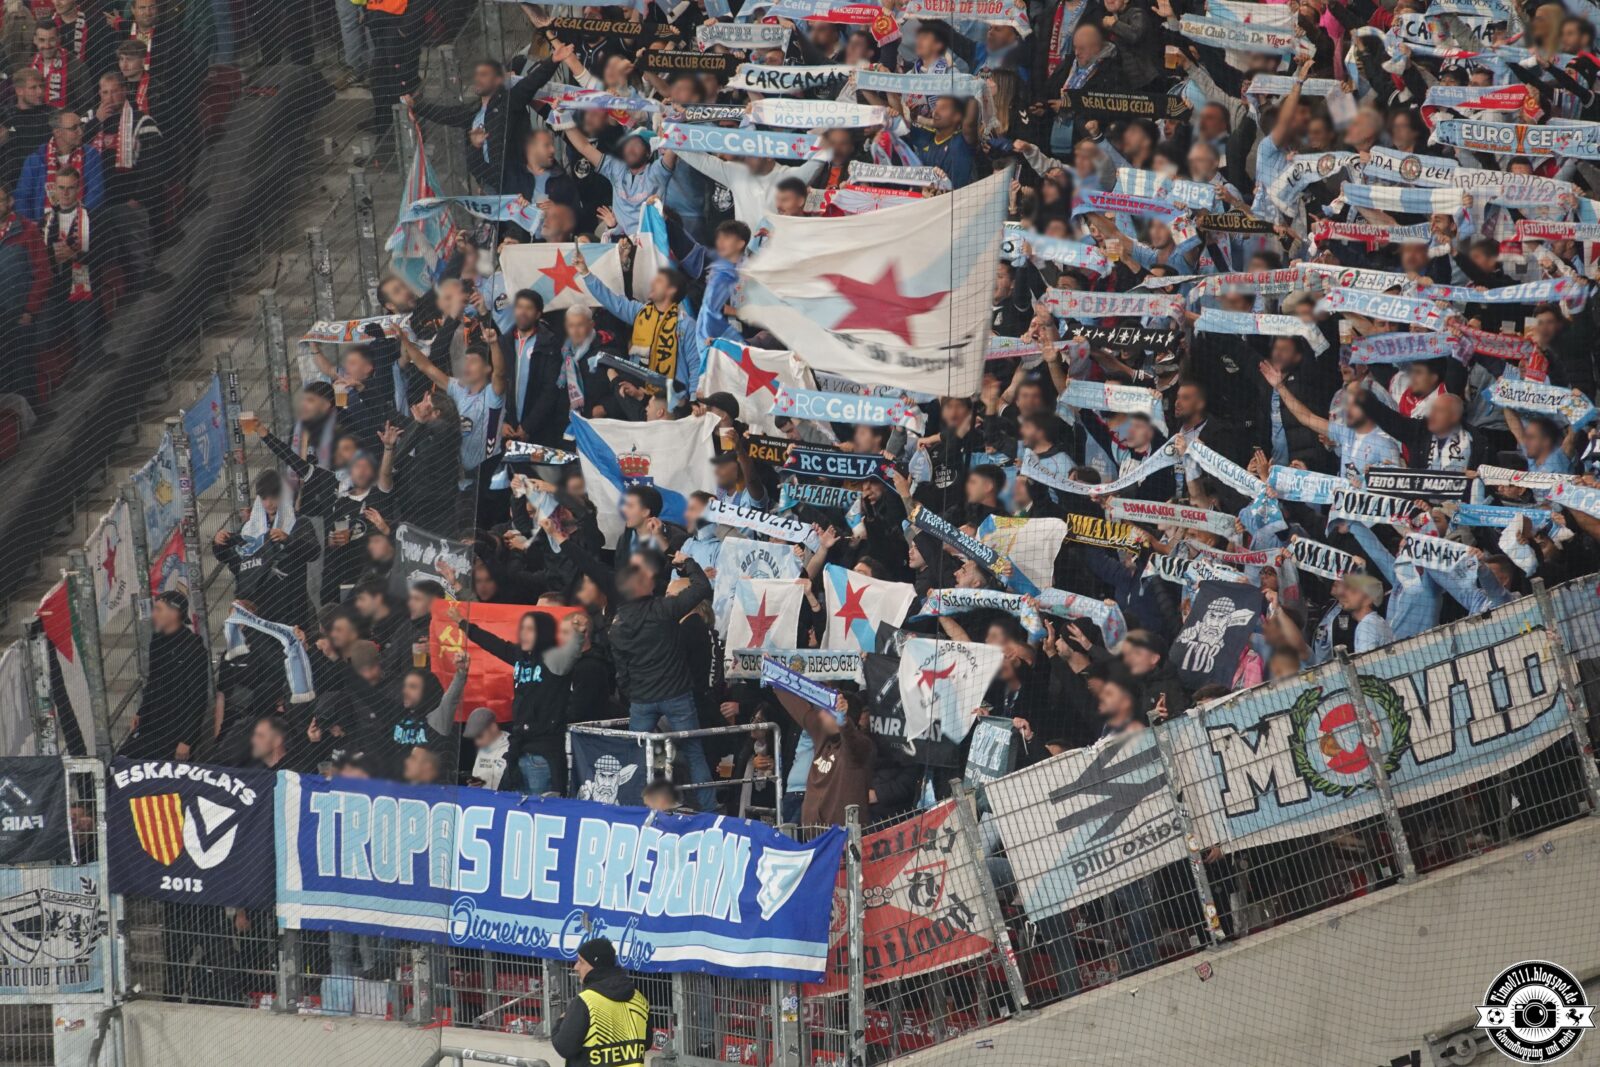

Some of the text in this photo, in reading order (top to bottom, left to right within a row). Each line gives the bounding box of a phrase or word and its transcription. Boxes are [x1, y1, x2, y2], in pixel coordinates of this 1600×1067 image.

[960, 2, 973, 14] DE
[977, 2, 1003, 14] VIGO
[554, 17, 642, 35] REAL CLUB CELTA
[1184, 22, 1203, 35] Real
[1205, 26, 1226, 39] Club
[1251, 32, 1263, 44] De
[1266, 35, 1285, 46] Vigo
[648, 54, 727, 70] REAL CLUB CELTA
[1082, 96, 1154, 114] REAL CLUB CELTA
[689, 129, 788, 156] RC Celta
[1461, 123, 1514, 145] EURO
[1219, 214, 1241, 228] CLUB
[1525, 223, 1571, 235] STUTTGART
[1274, 270, 1298, 283] VIGO
[795, 393, 885, 422] RC Celta
[749, 445, 780, 462] REAL
[801, 456, 877, 475] RC CELTA
[1368, 474, 1394, 488] FEITO
[1122, 502, 1176, 517] COMANDO
[1180, 509, 1208, 522] CELTA
[1181, 641, 1221, 674] TDB
[869, 715, 902, 736] FAIR
[114, 761, 257, 806] ESKAPULATS
[309, 790, 751, 924] TROPAS DE BREOGÁN
[160, 875, 203, 893] 2013
[451, 895, 553, 949] Siareiros
[617, 916, 656, 970] Vigo
